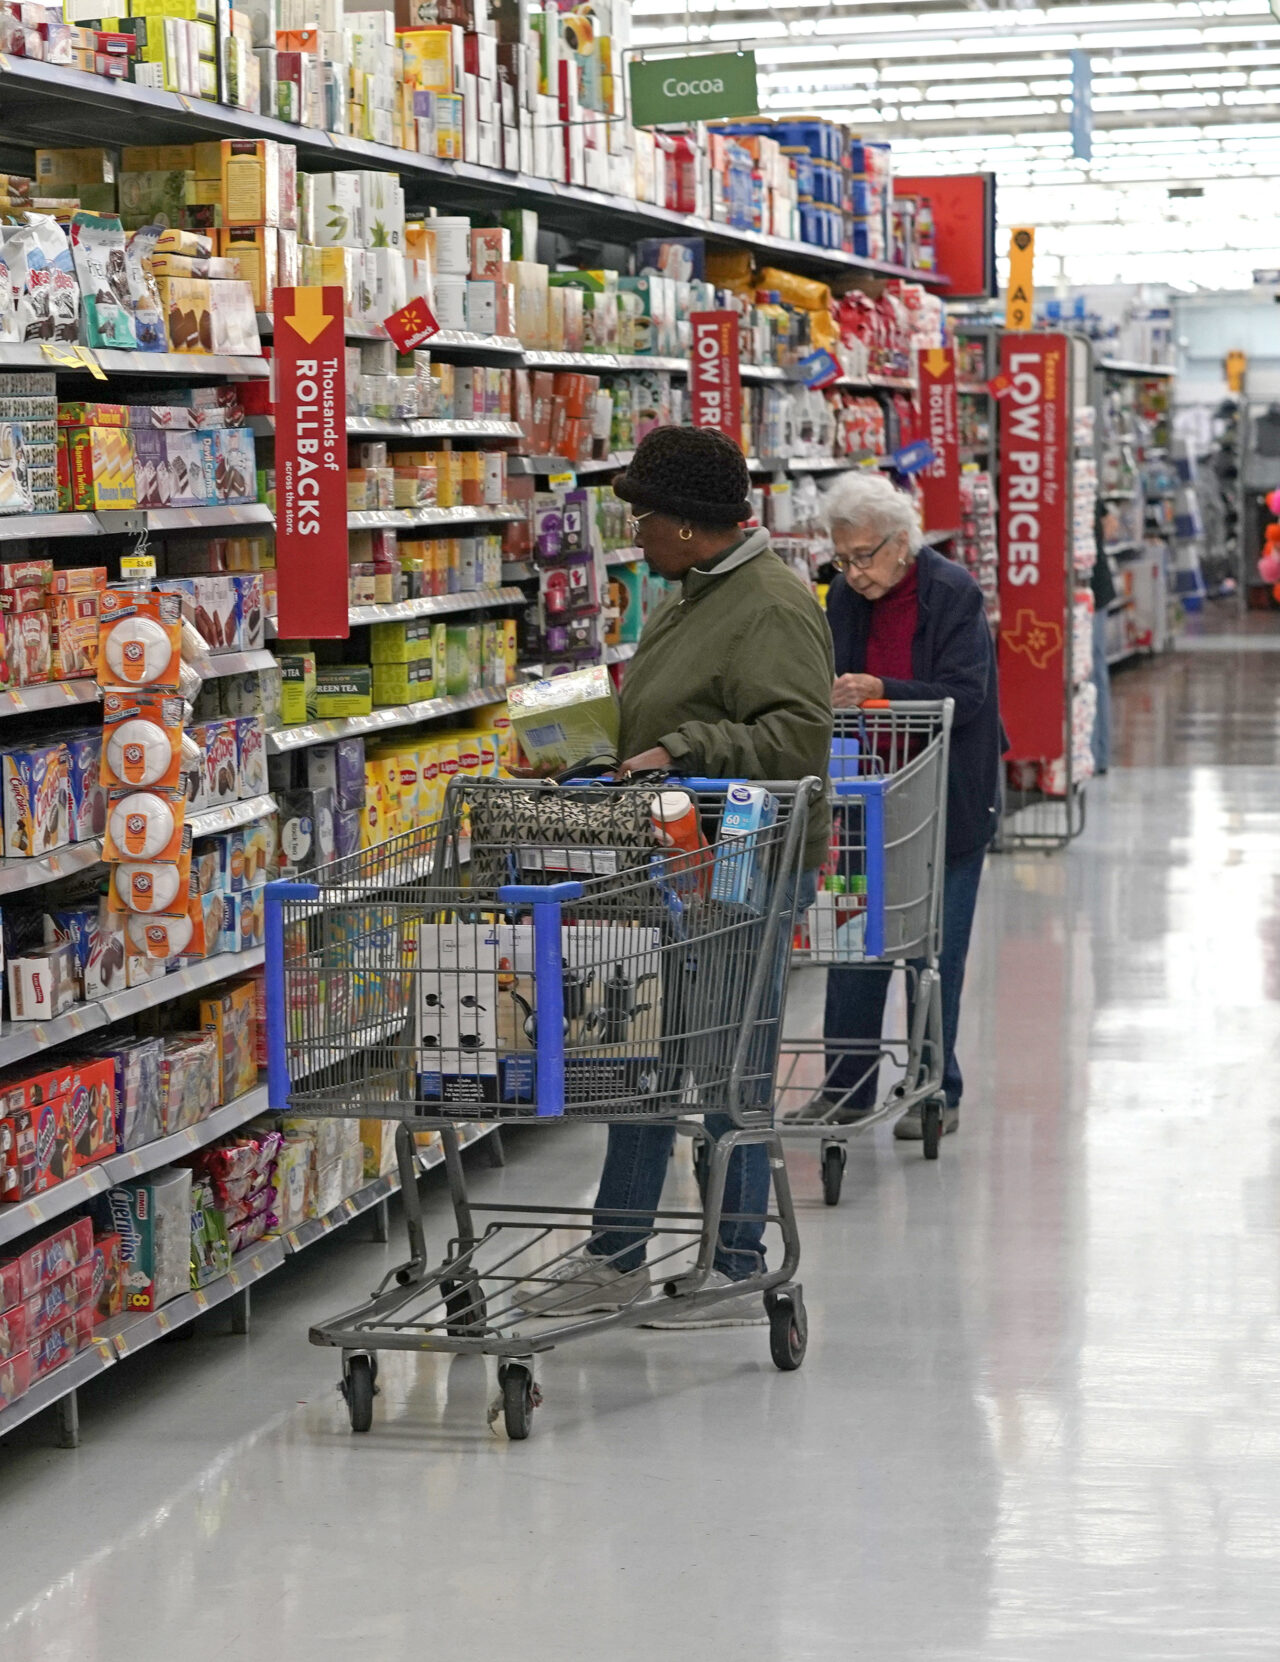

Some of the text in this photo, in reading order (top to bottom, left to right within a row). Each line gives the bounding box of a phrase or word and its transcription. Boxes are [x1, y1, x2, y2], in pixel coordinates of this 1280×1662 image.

[662, 76, 724, 98] Cocoa
[1011, 287, 1028, 303] A
[1013, 310, 1024, 325] 9
[404, 325, 434, 348] Rollback
[697, 324, 722, 431] LOW PRI
[723, 386, 732, 410] here
[322, 358, 339, 471] Thousands of
[724, 411, 734, 426] for
[929, 385, 946, 478] ROLLBACKS
[1044, 352, 1059, 504] Texans come here for
[203, 438, 211, 461] Devil
[296, 359, 320, 535] ROLLBACKS
[75, 446, 87, 494] Banana Twins
[1008, 353, 1041, 586] LOW PRICES
[285, 461, 295, 536] across the store.
[287, 669, 300, 677] TEA
[340, 684, 358, 692] TEA
[726, 815, 740, 825] 60
[106, 1187, 142, 1263] Cuernitos
[132, 1293, 150, 1307] 8
